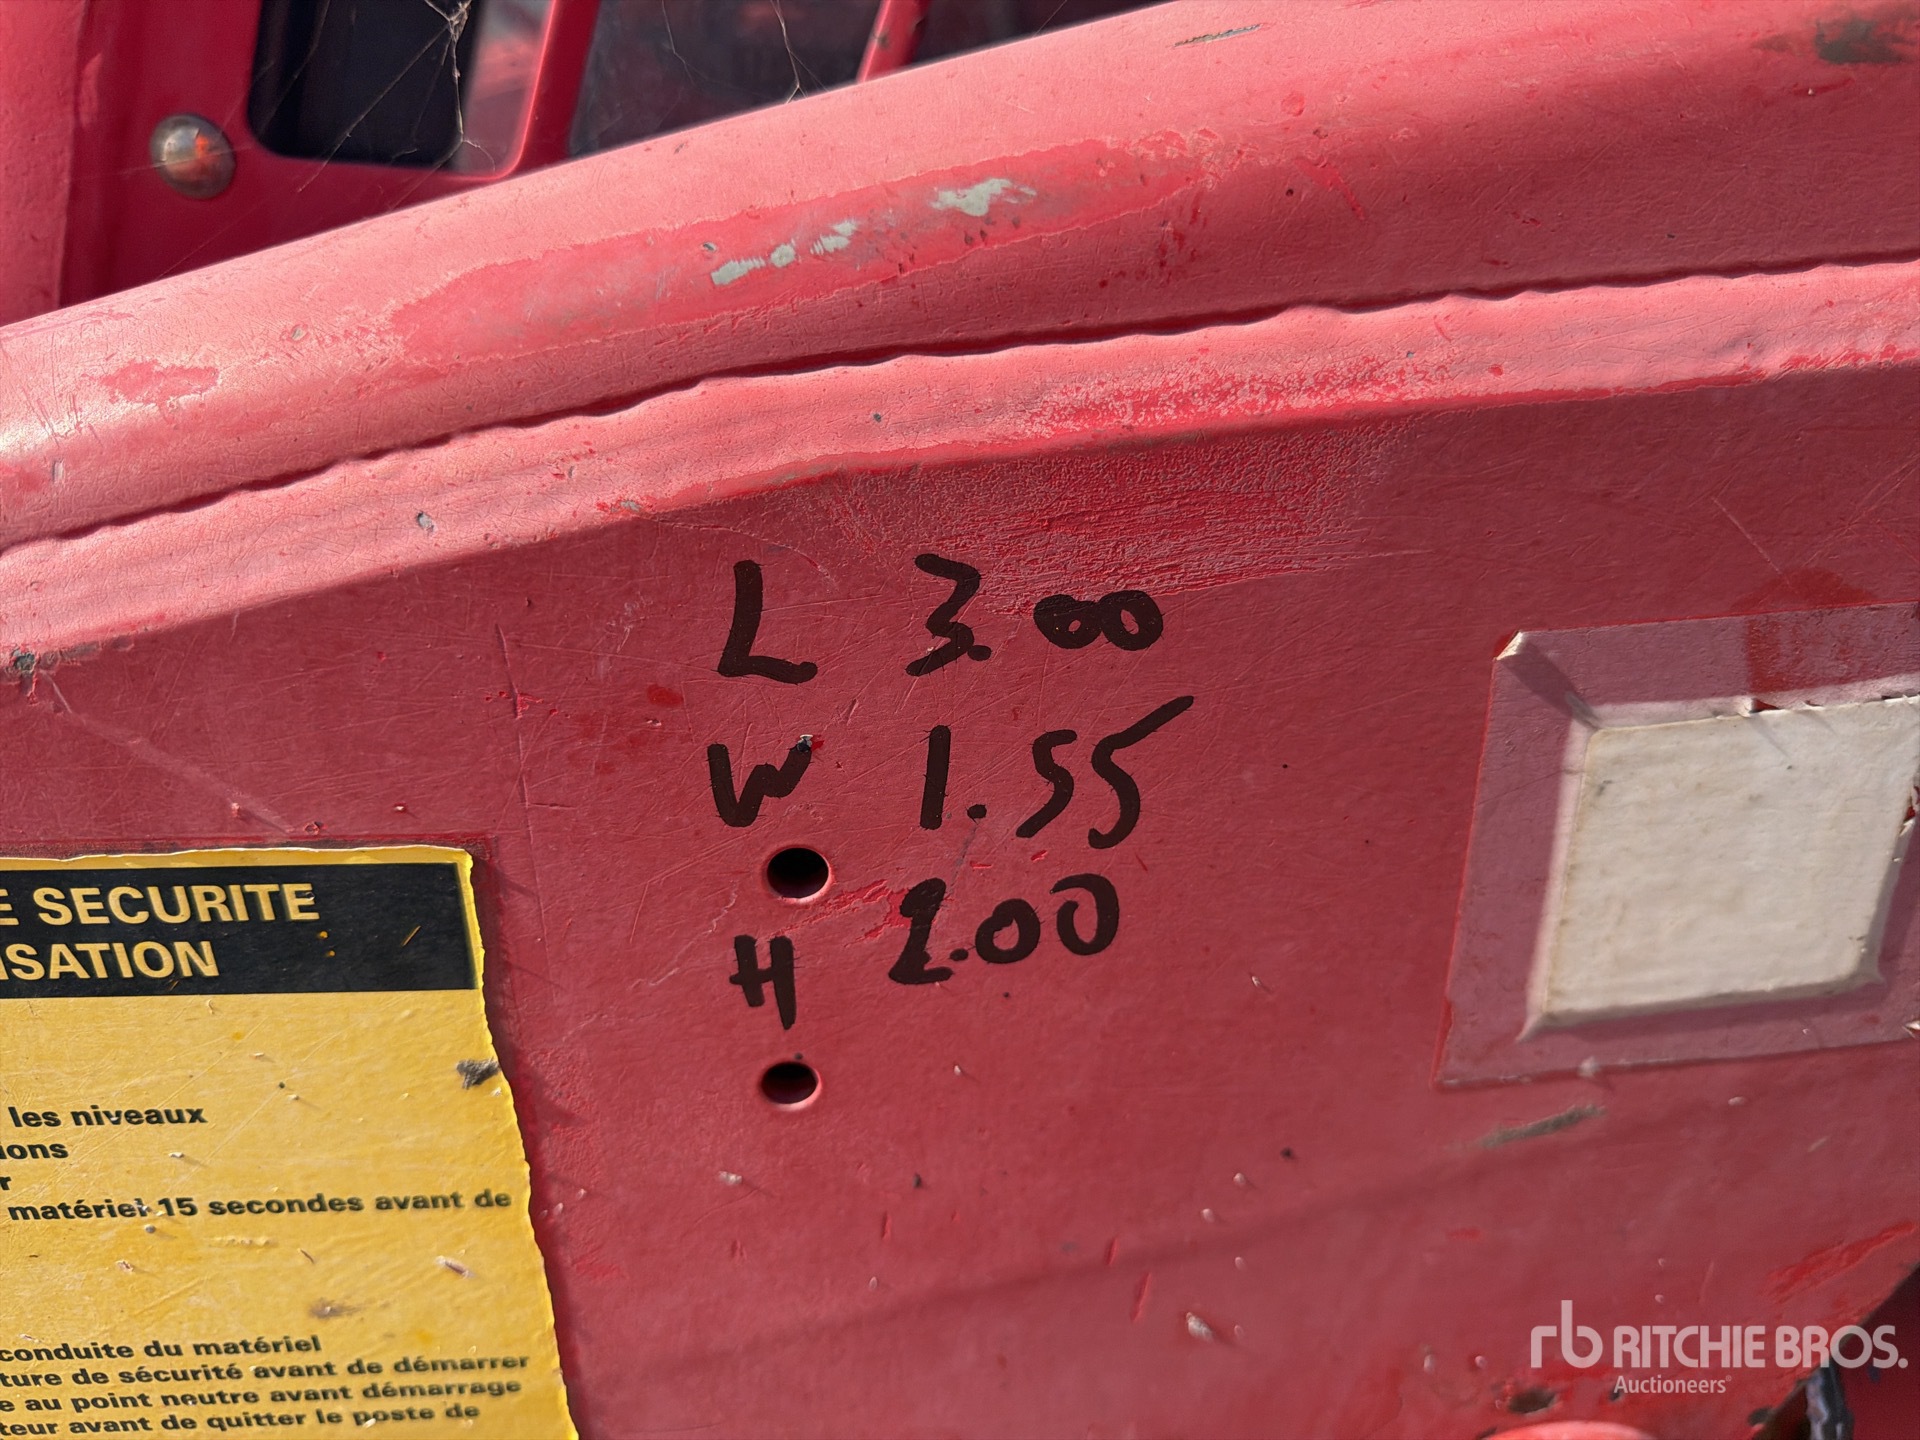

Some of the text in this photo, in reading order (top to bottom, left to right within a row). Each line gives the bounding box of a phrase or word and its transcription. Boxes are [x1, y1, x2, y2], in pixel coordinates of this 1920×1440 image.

[717, 553, 1164, 684] L 3.00
[706, 695, 1194, 849] W 1.55
[32, 883, 320, 926] SECURITE
[729, 872, 1120, 1029] H 2.00
[8, 1105, 208, 1127] les niveaux
[8, 1188, 512, 1221] matériel 15 secondes avant de
[0, 1335, 322, 1362] conduite du matériel
[0, 1355, 530, 1388] ture de sécurité avant de démarrer
[25, 1398, 62, 1411] au
[70, 1393, 153, 1413] point
[160, 1390, 260, 1407] neutre
[270, 1385, 353, 1402] avant
[362, 1380, 522, 1399] démarrage
[0, 1402, 480, 1436] teur avant de quitter le poste de
